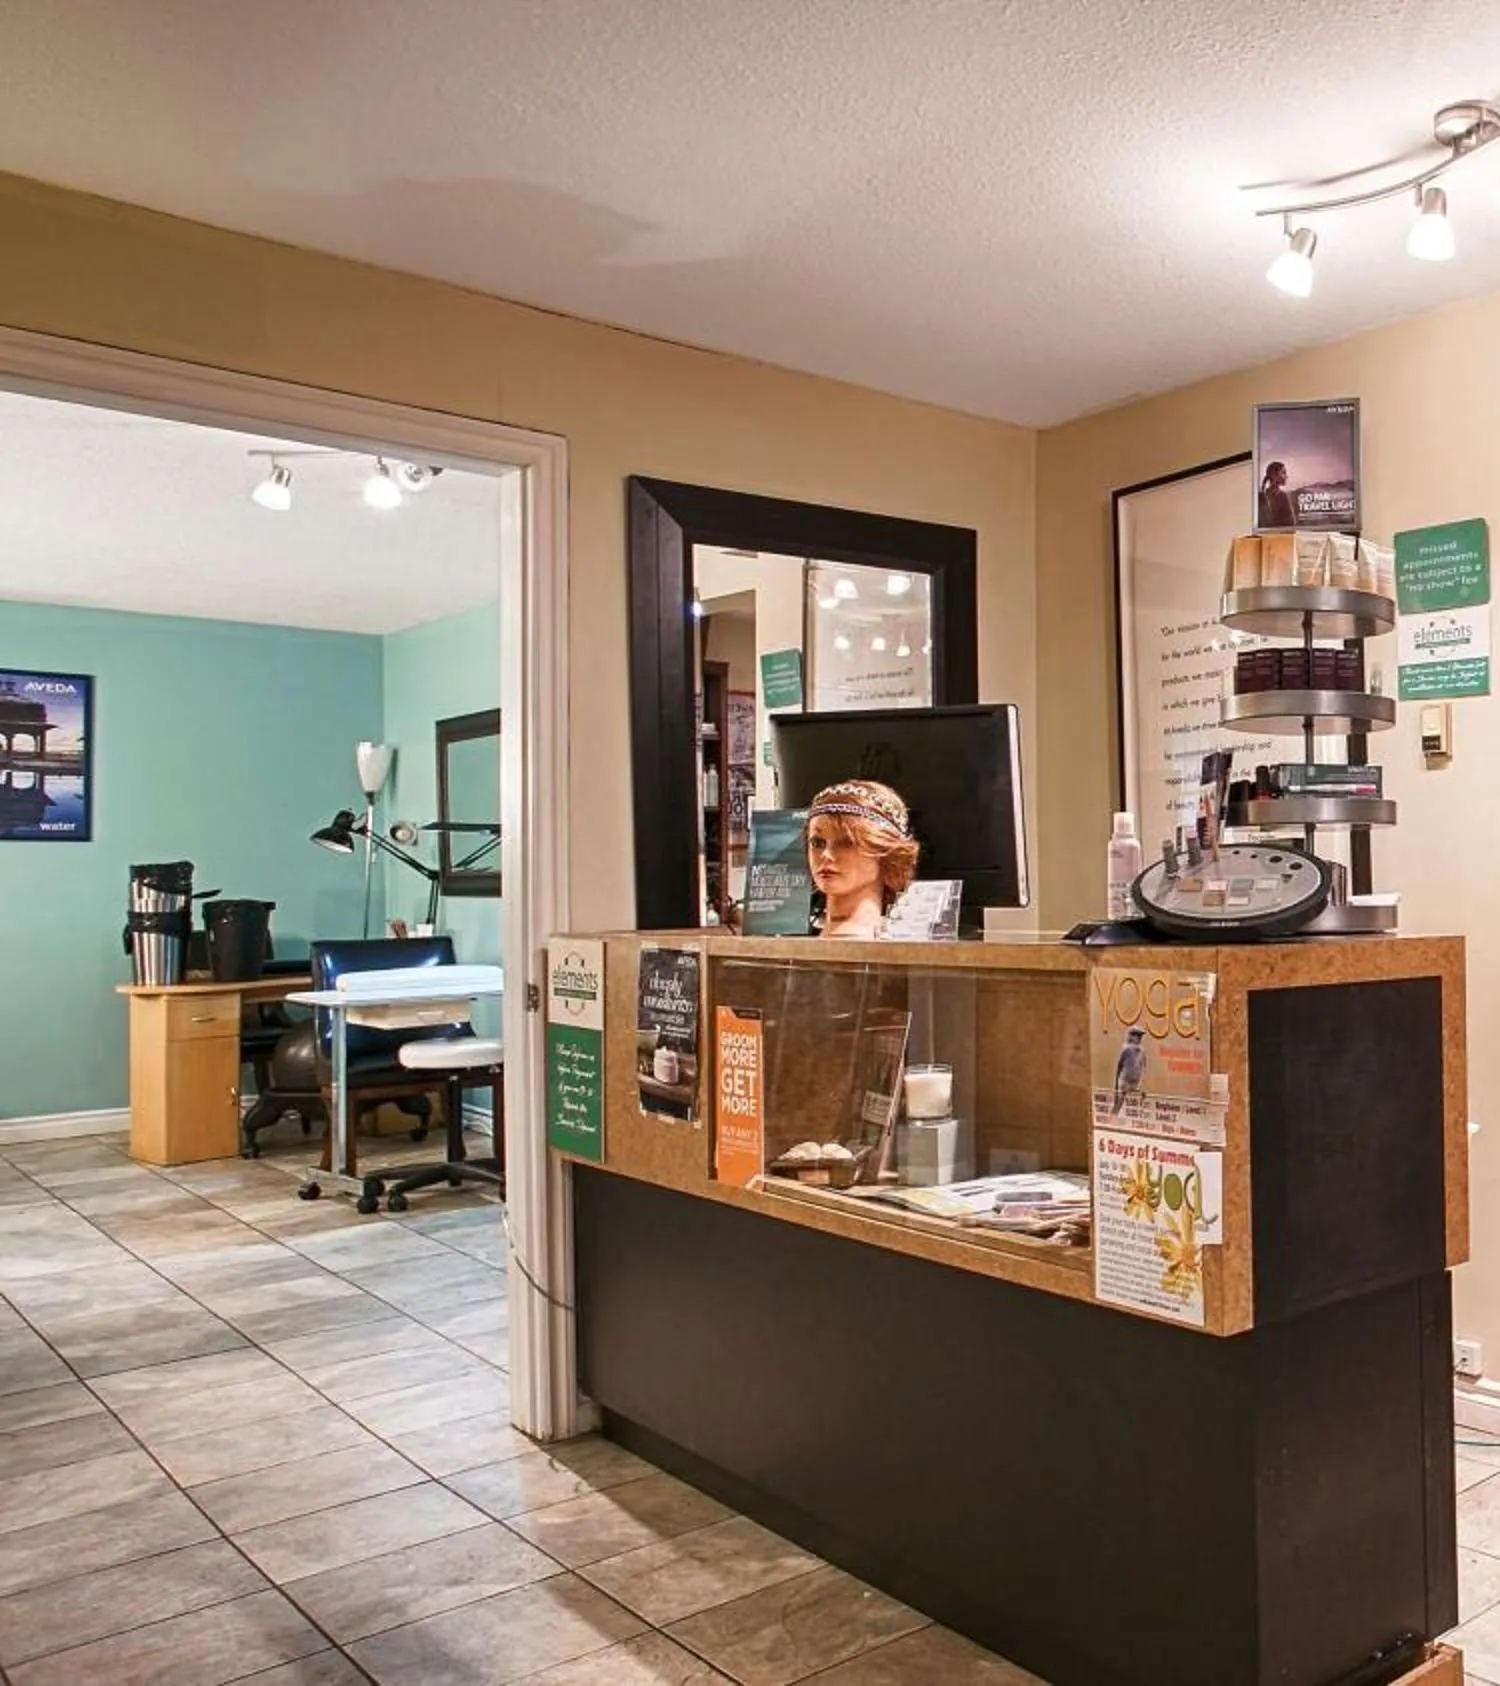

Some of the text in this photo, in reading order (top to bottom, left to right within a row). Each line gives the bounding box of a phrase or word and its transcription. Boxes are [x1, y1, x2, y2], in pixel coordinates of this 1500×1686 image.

[1413, 623, 1473, 643] elements
[24, 681, 77, 693] AVEDA
[39, 821, 76, 832] water
[552, 964, 599, 991] elements
[721, 1031, 757, 1048] GROOM
[721, 1047, 757, 1067] MORE
[721, 1068, 757, 1097] GET
[721, 1096, 757, 1117] MORE
[1099, 1138, 1105, 1153] 6
[1108, 1139, 1135, 1159] Days
[1137, 1144, 1150, 1160] of
